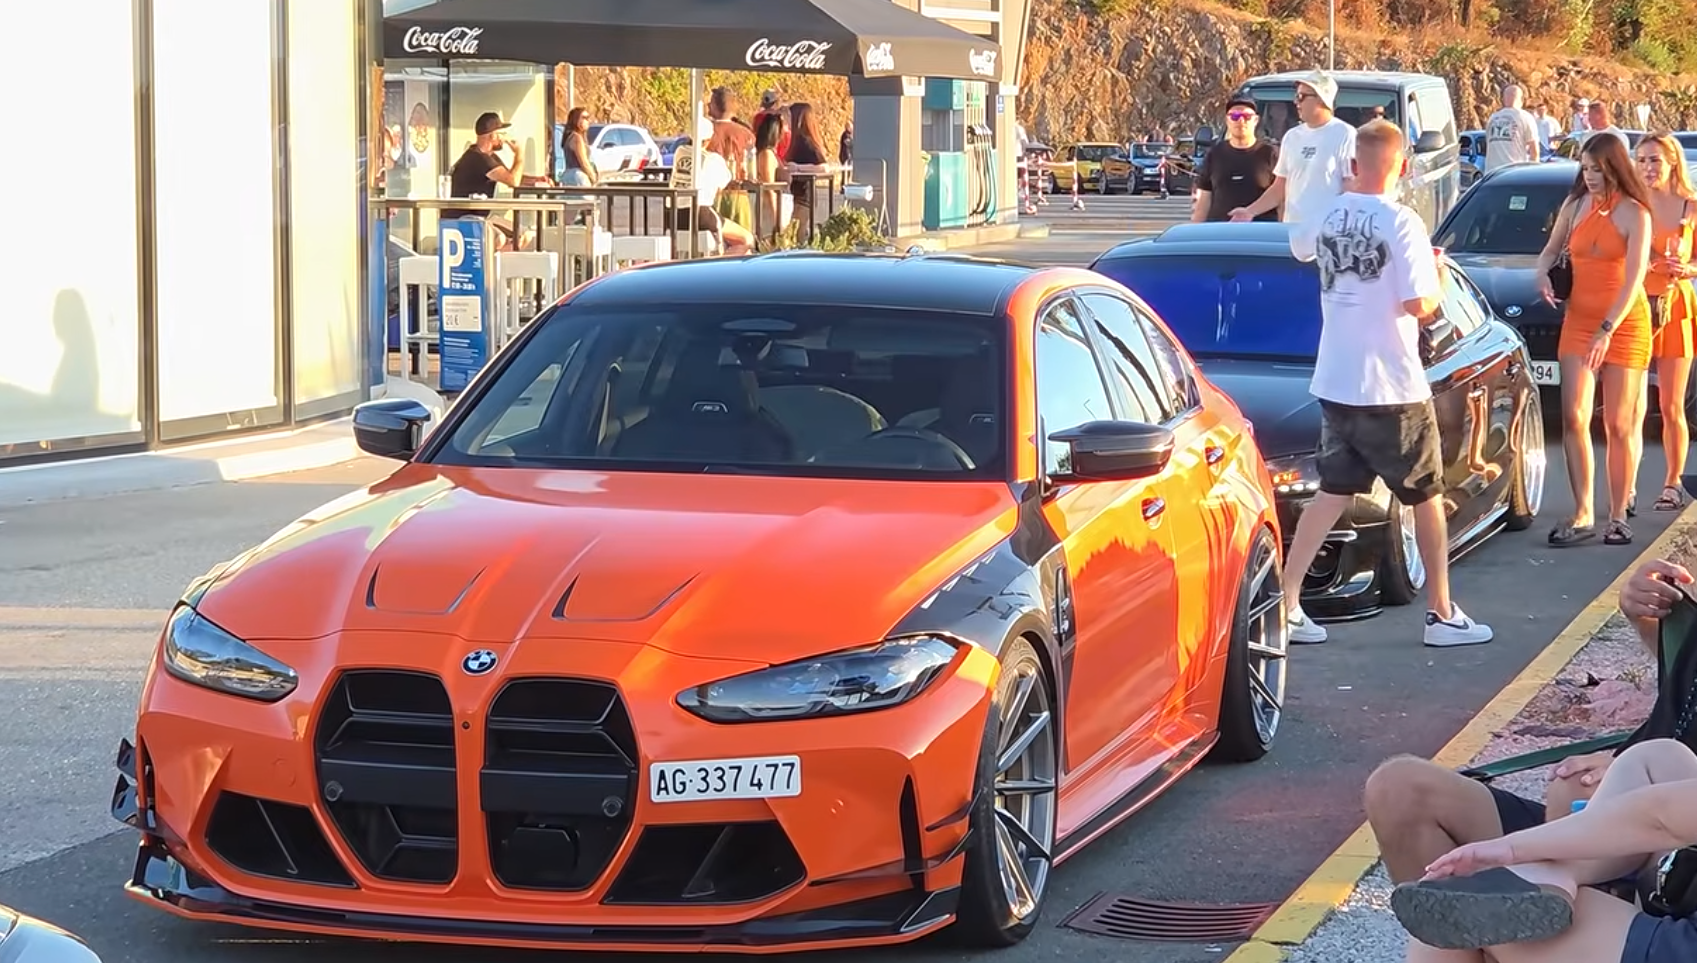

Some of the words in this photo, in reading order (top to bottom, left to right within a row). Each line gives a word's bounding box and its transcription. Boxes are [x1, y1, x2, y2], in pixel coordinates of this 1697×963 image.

[403, 26, 483, 54] Coca-Cola
[745, 38, 832, 69] Coca-Cola
[442, 228, 465, 289] P
